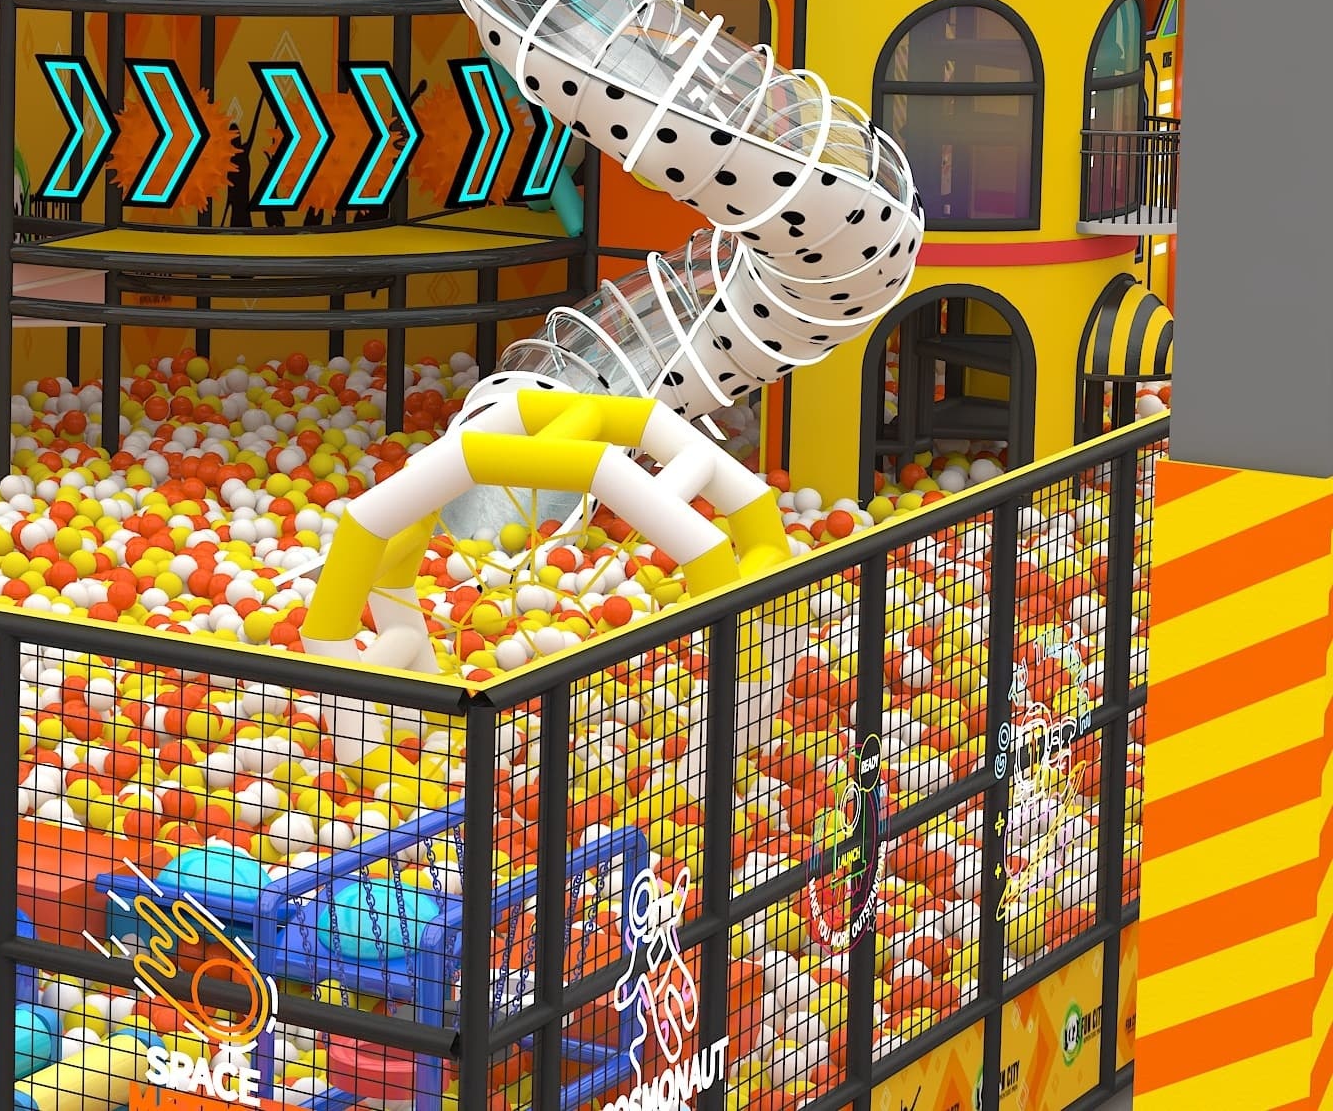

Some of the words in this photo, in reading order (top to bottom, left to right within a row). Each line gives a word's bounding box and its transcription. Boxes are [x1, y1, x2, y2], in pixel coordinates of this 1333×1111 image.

[861, 753, 879, 774] READY
[994, 721, 1011, 779] GO
[837, 845, 861, 869] LAUNCH
[818, 915, 831, 942] YOU
[145, 1045, 261, 1107] SPACE
[602, 1035, 729, 1111] SMONAUT
